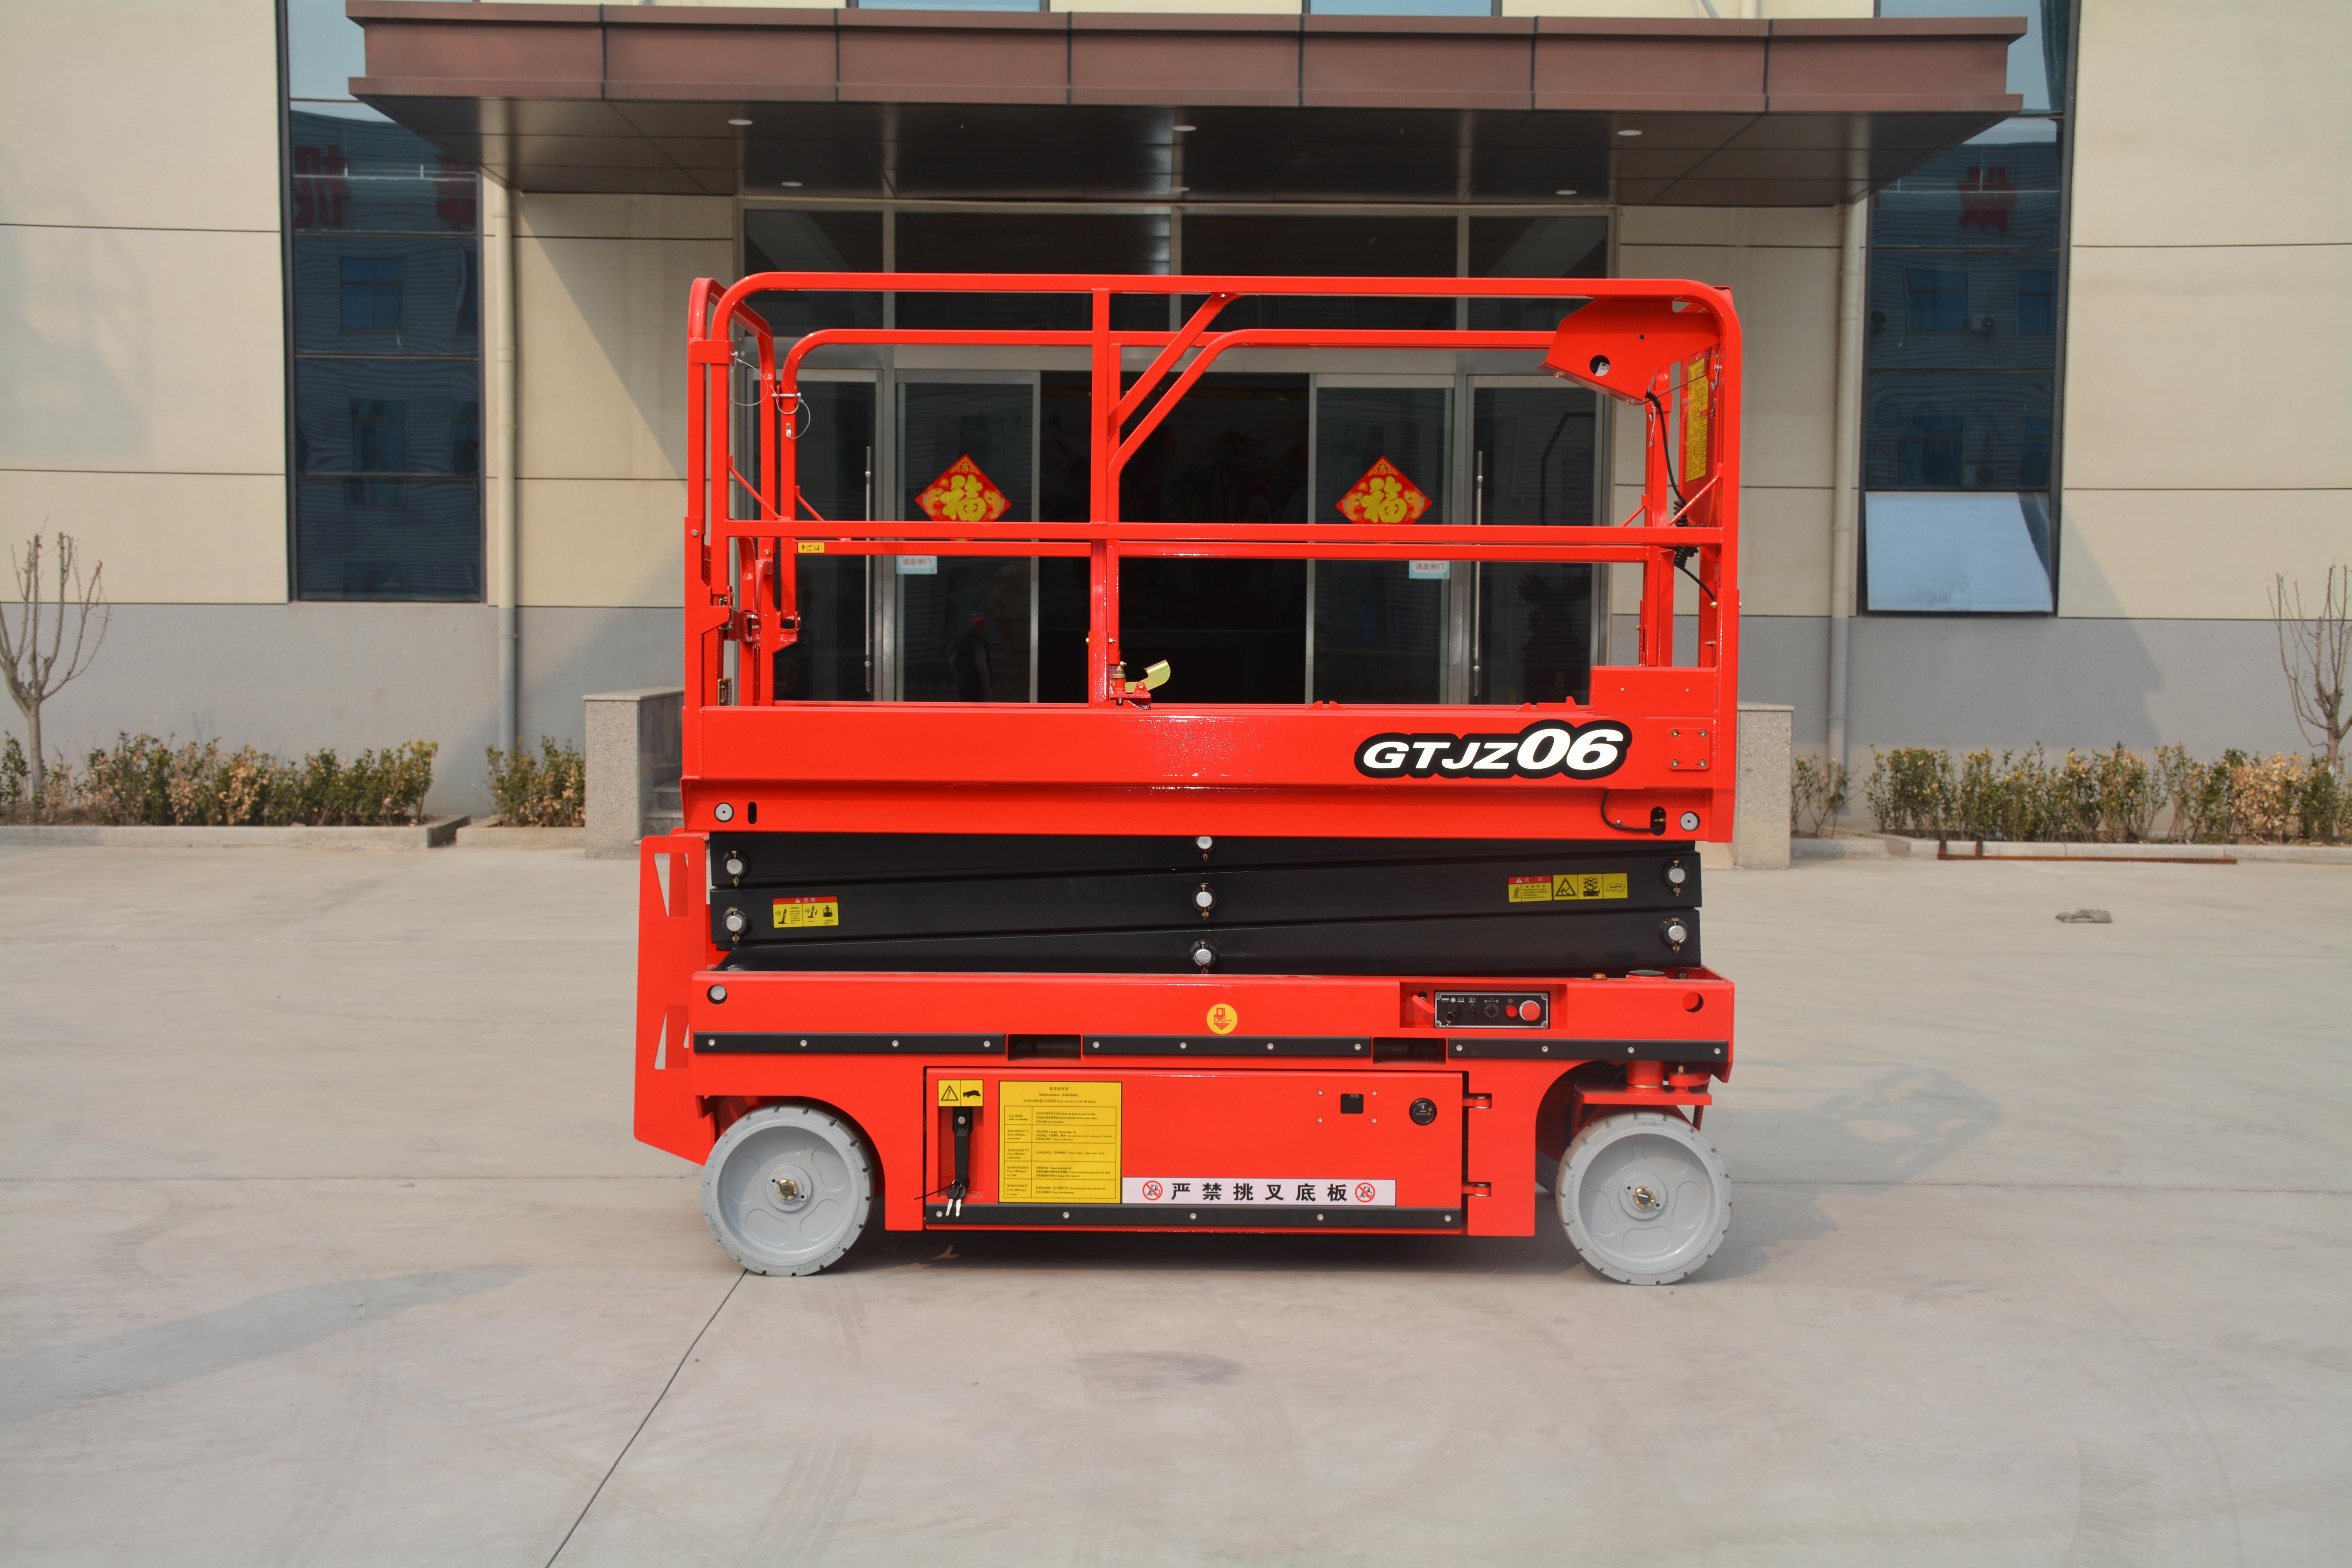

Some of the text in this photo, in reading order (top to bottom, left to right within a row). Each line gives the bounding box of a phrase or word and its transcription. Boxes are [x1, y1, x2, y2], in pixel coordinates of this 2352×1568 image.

[940, 474, 987, 521] 福
[1360, 475, 1408, 524] 福
[1363, 728, 1623, 770] GTJZ06
[1171, 1182, 1348, 1202] 严禁挑叉底板
